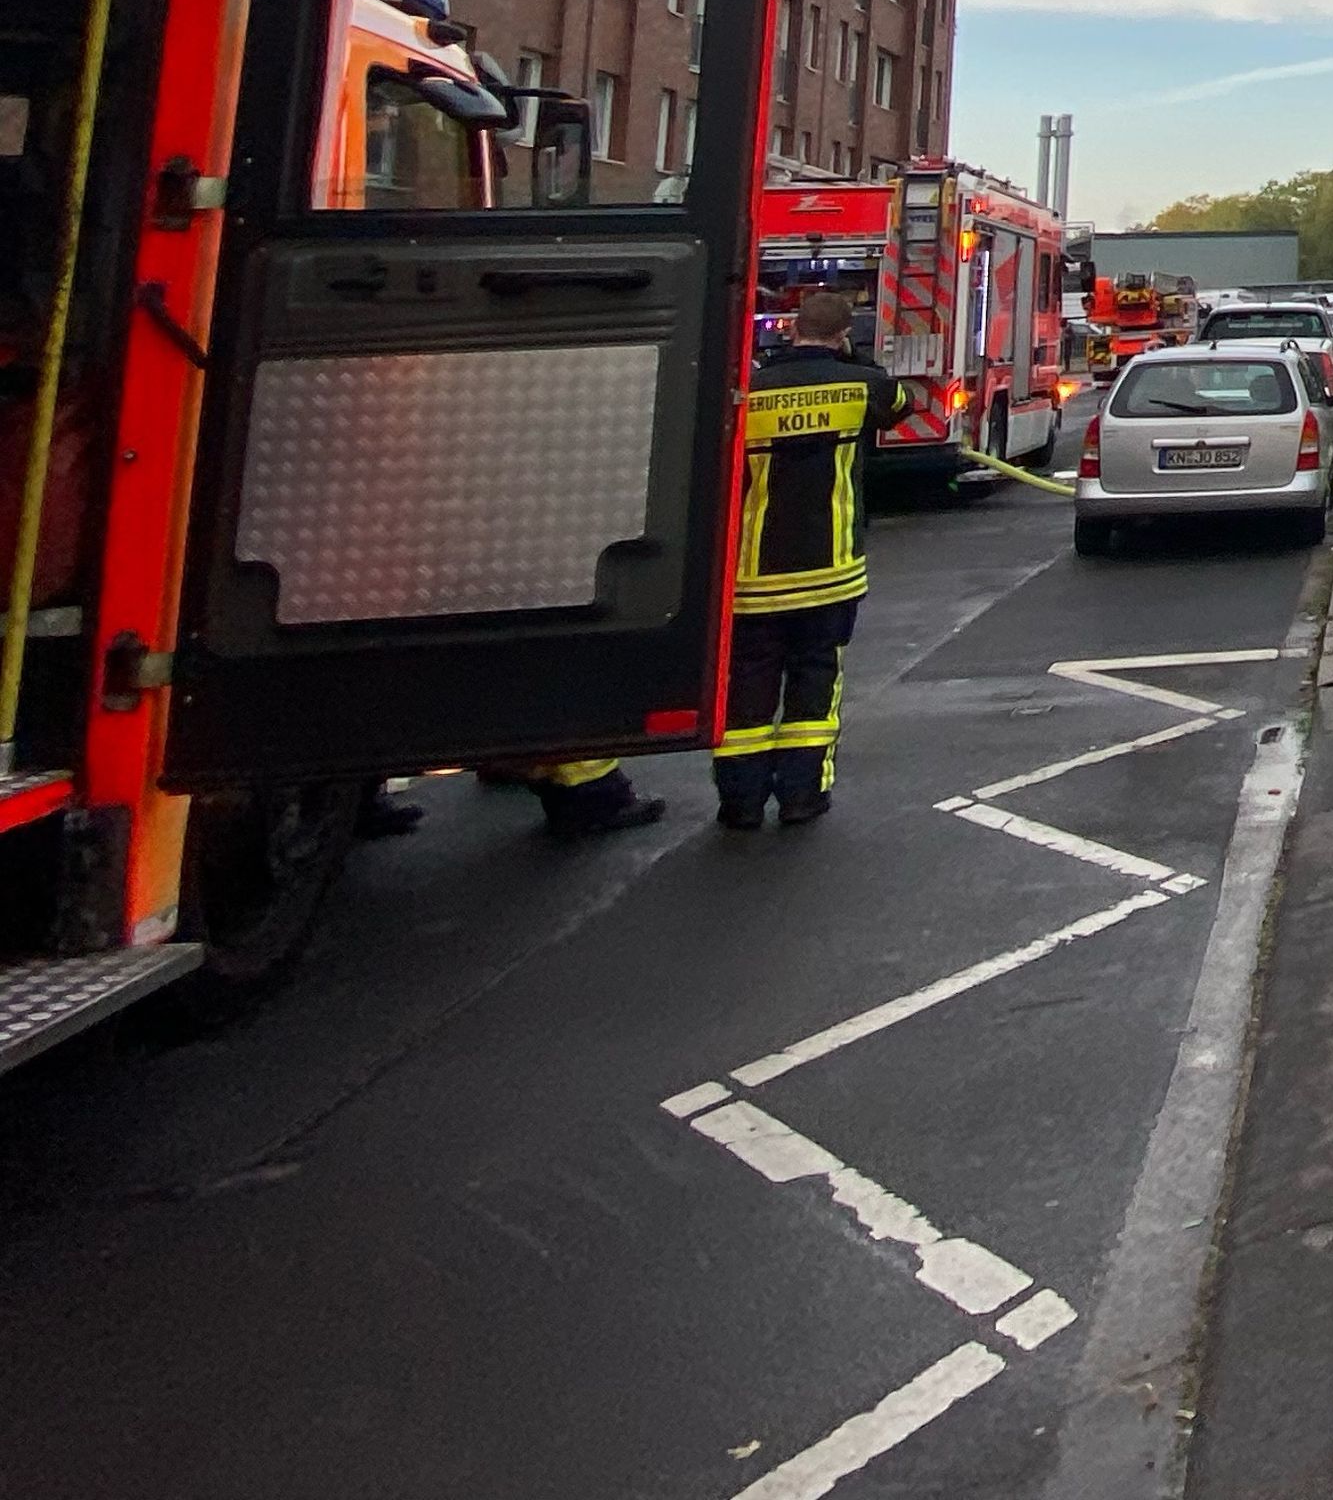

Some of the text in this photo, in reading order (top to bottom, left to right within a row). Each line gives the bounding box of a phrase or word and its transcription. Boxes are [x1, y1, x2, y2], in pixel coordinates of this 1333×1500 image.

[750, 387, 865, 412] ERUFSFEUERWEHR
[777, 410, 830, 432] KÖLN
[1167, 451, 1185, 464] KN
